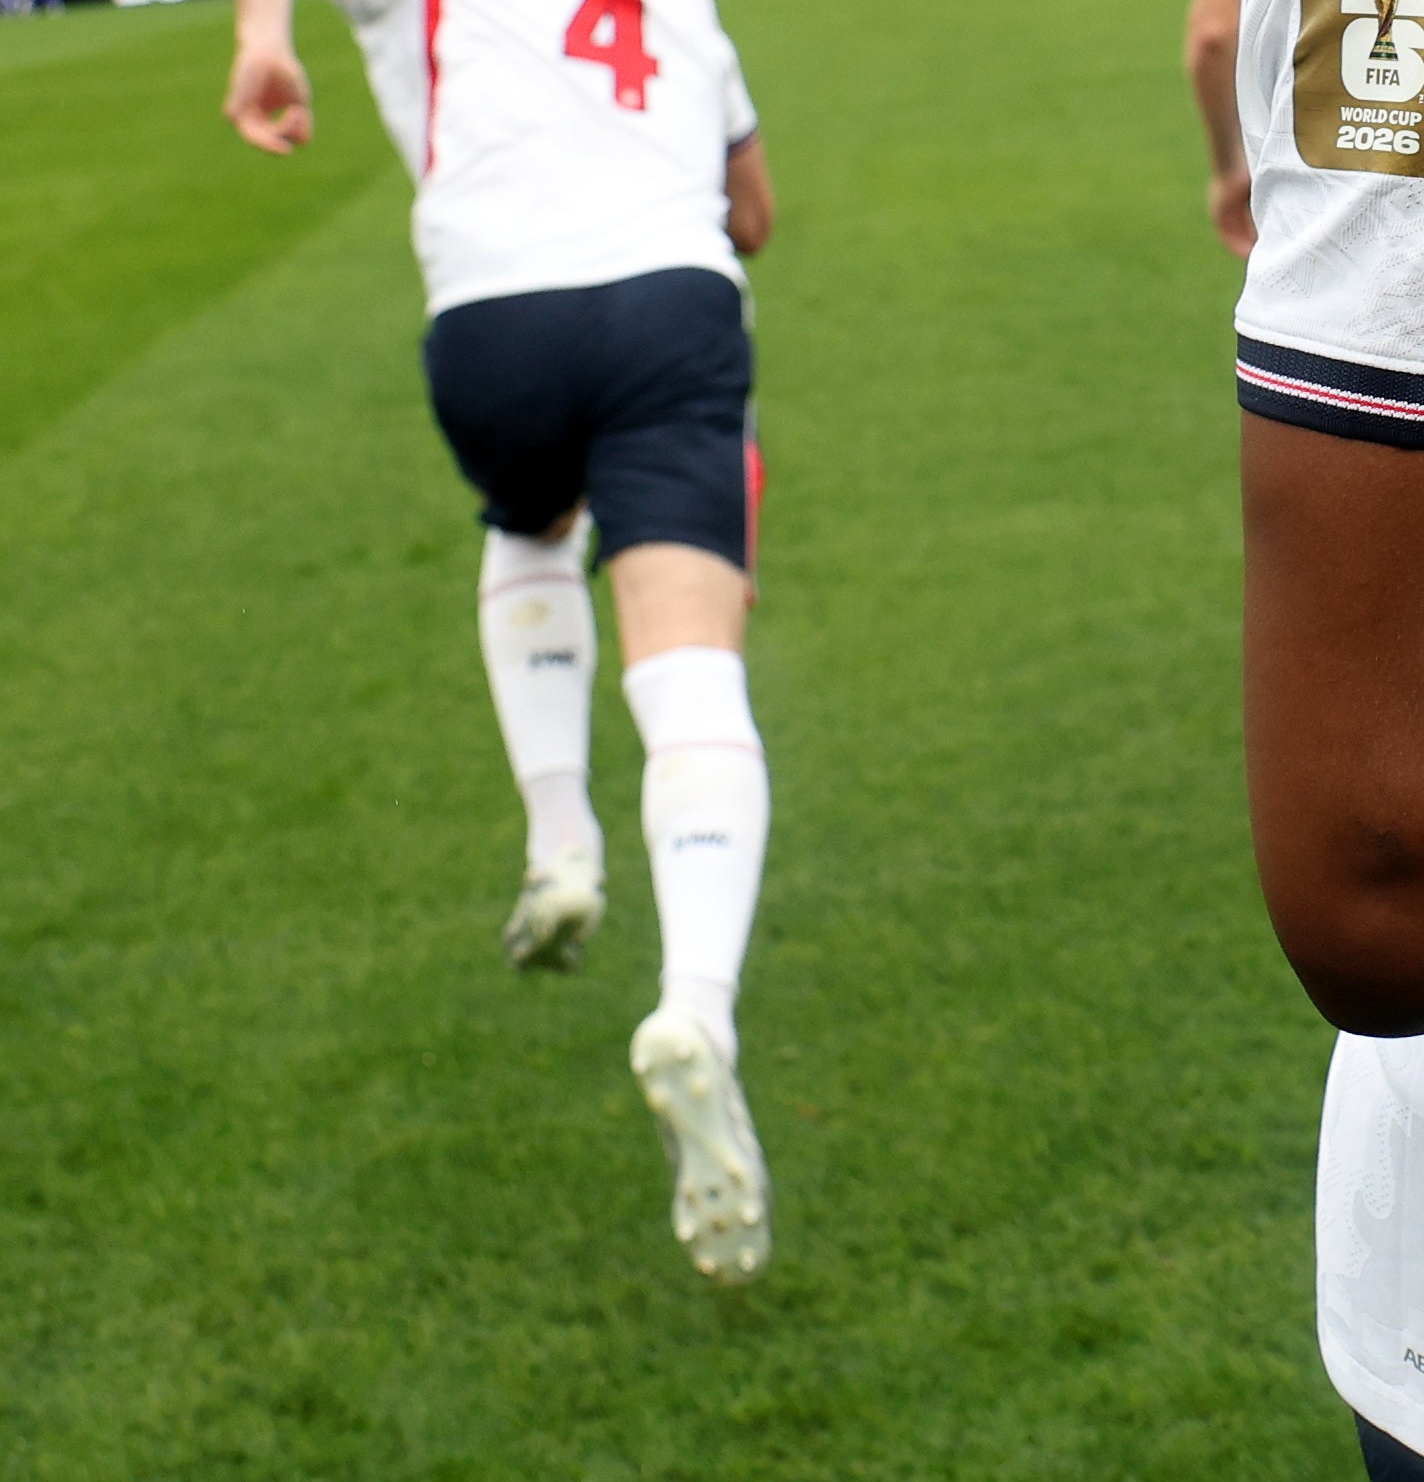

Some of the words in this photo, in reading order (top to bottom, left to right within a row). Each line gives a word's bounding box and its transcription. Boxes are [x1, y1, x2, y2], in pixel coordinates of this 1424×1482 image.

[1365, 67, 1401, 86] FIFA
[1340, 106, 1388, 123] WORLD
[1388, 110, 1423, 126] CUP
[1336, 125, 1421, 155] 2026
